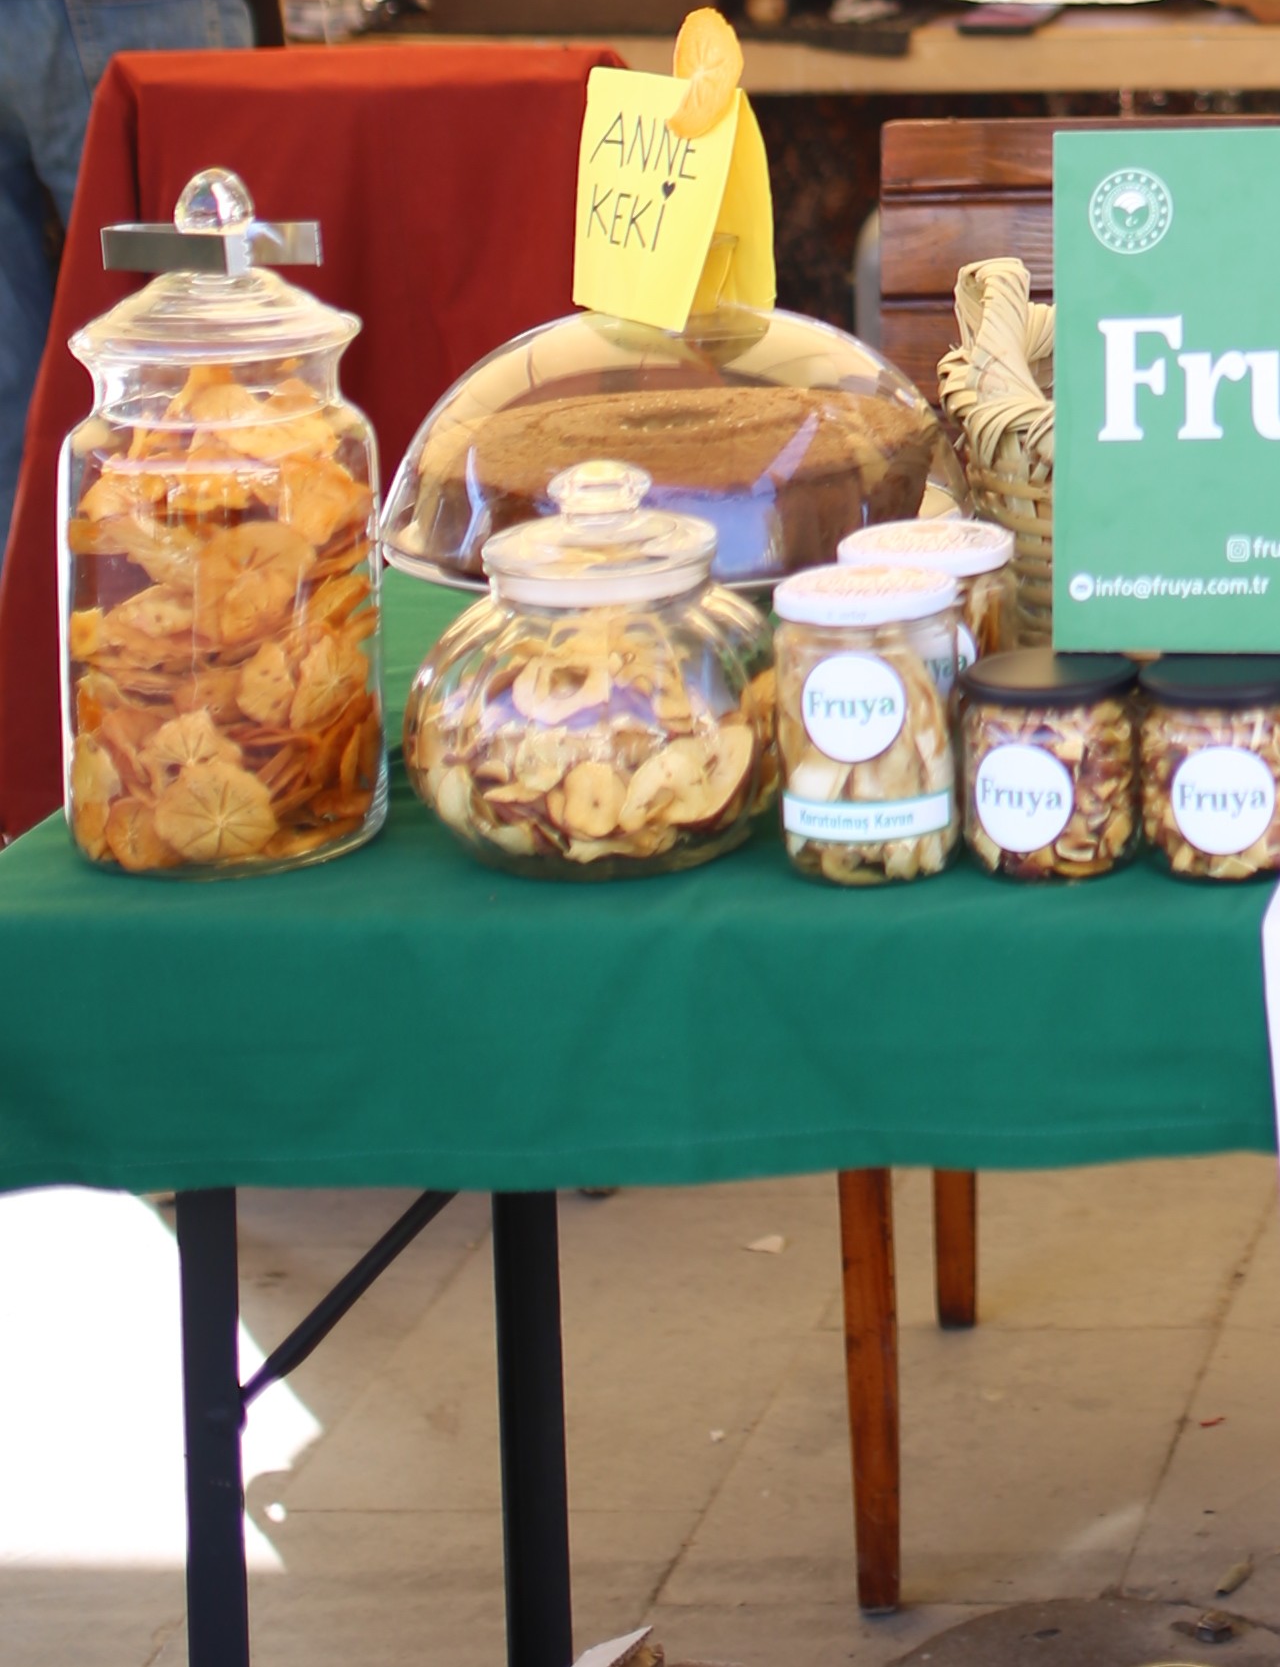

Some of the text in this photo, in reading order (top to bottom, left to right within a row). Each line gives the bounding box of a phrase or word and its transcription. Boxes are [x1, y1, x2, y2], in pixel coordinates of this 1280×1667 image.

[589, 110, 698, 181] ANNE
[1095, 574, 1271, 600] info@fruya.com.tr
[807, 690, 897, 726] Fruya
[980, 777, 1063, 818] Fruya
[1177, 782, 1267, 817] Fruya
